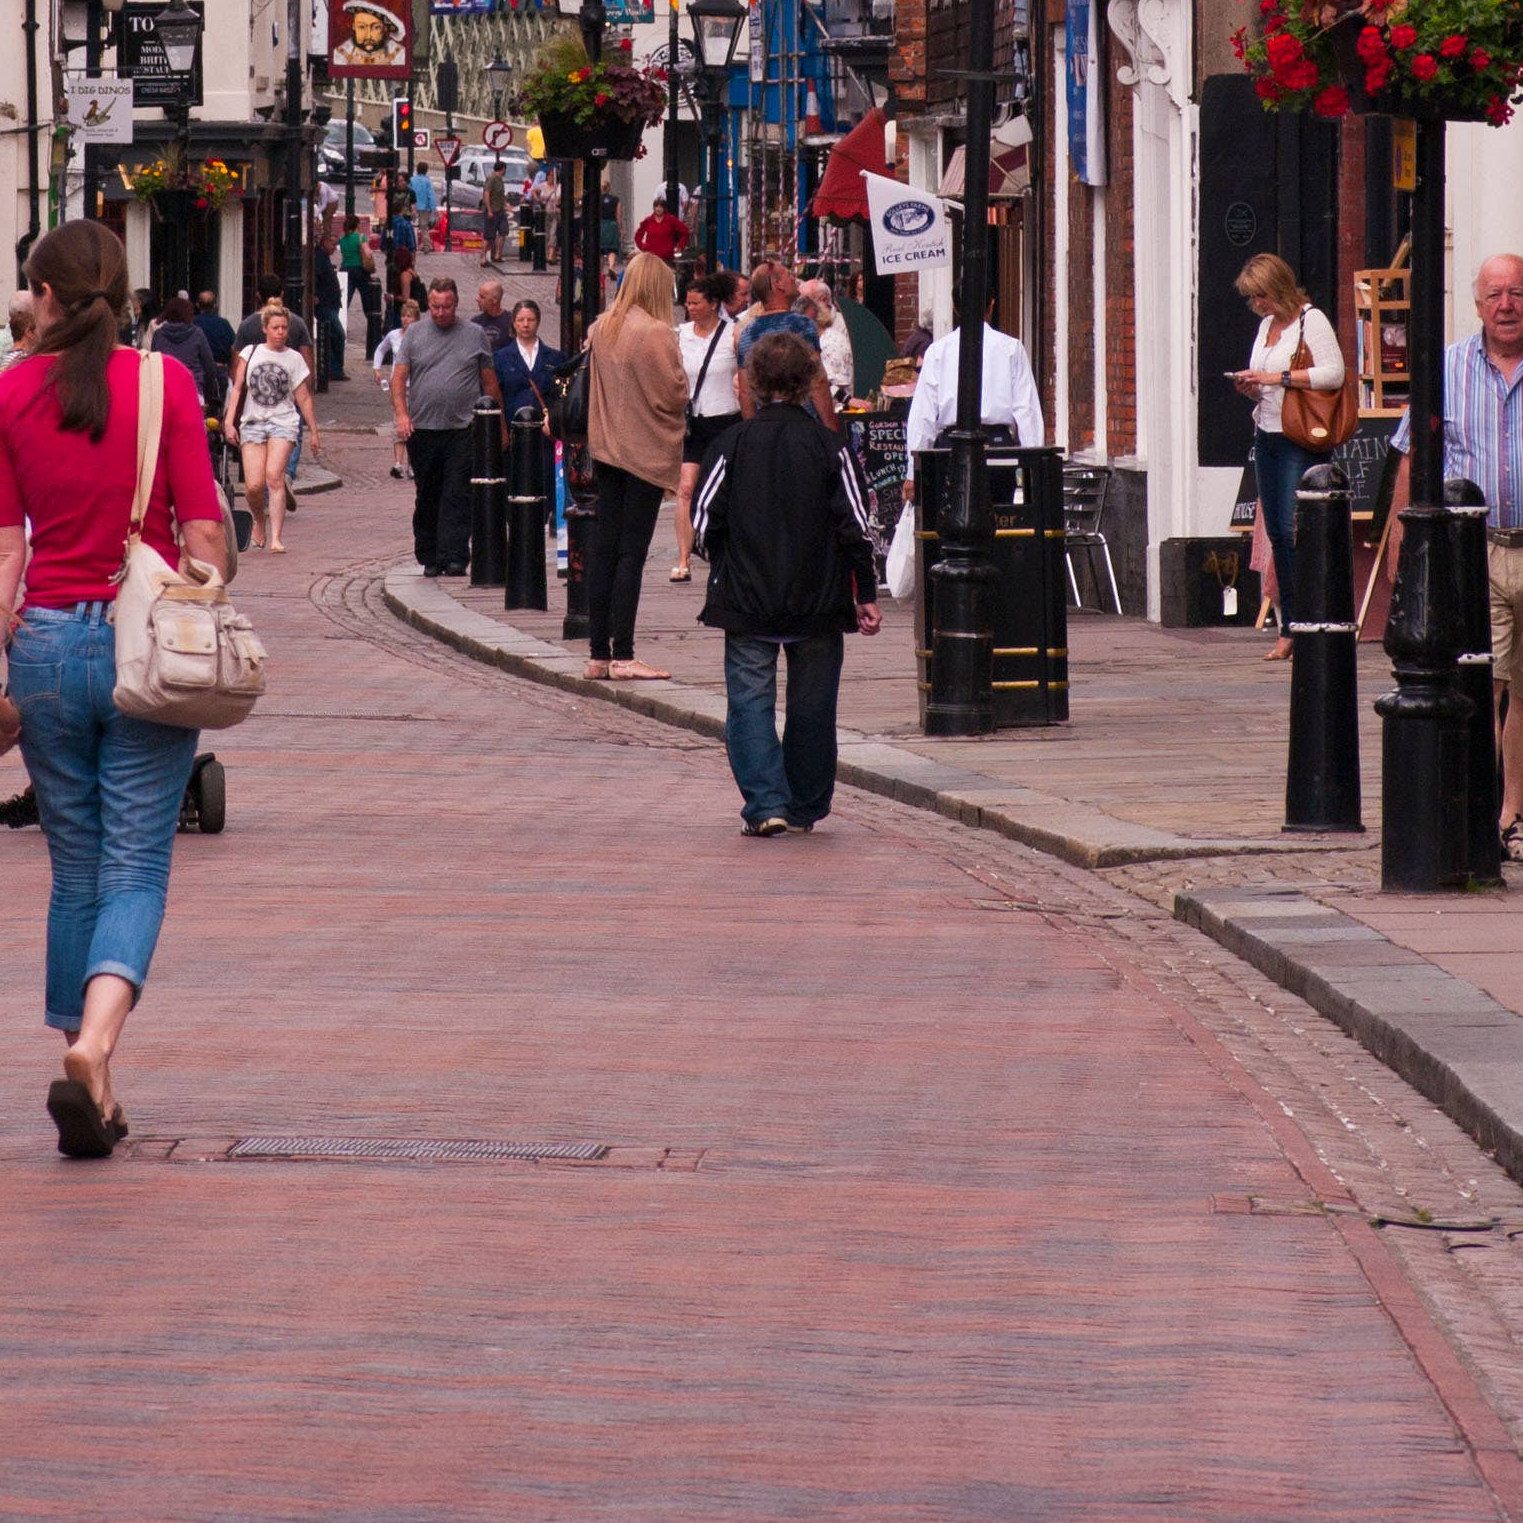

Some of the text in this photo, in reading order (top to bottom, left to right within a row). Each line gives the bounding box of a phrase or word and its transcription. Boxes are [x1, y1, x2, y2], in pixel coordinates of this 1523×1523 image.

[78, 86, 96, 95] DIG
[98, 86, 131, 95] DINOS
[882, 249, 945, 264] ICE CREAM
